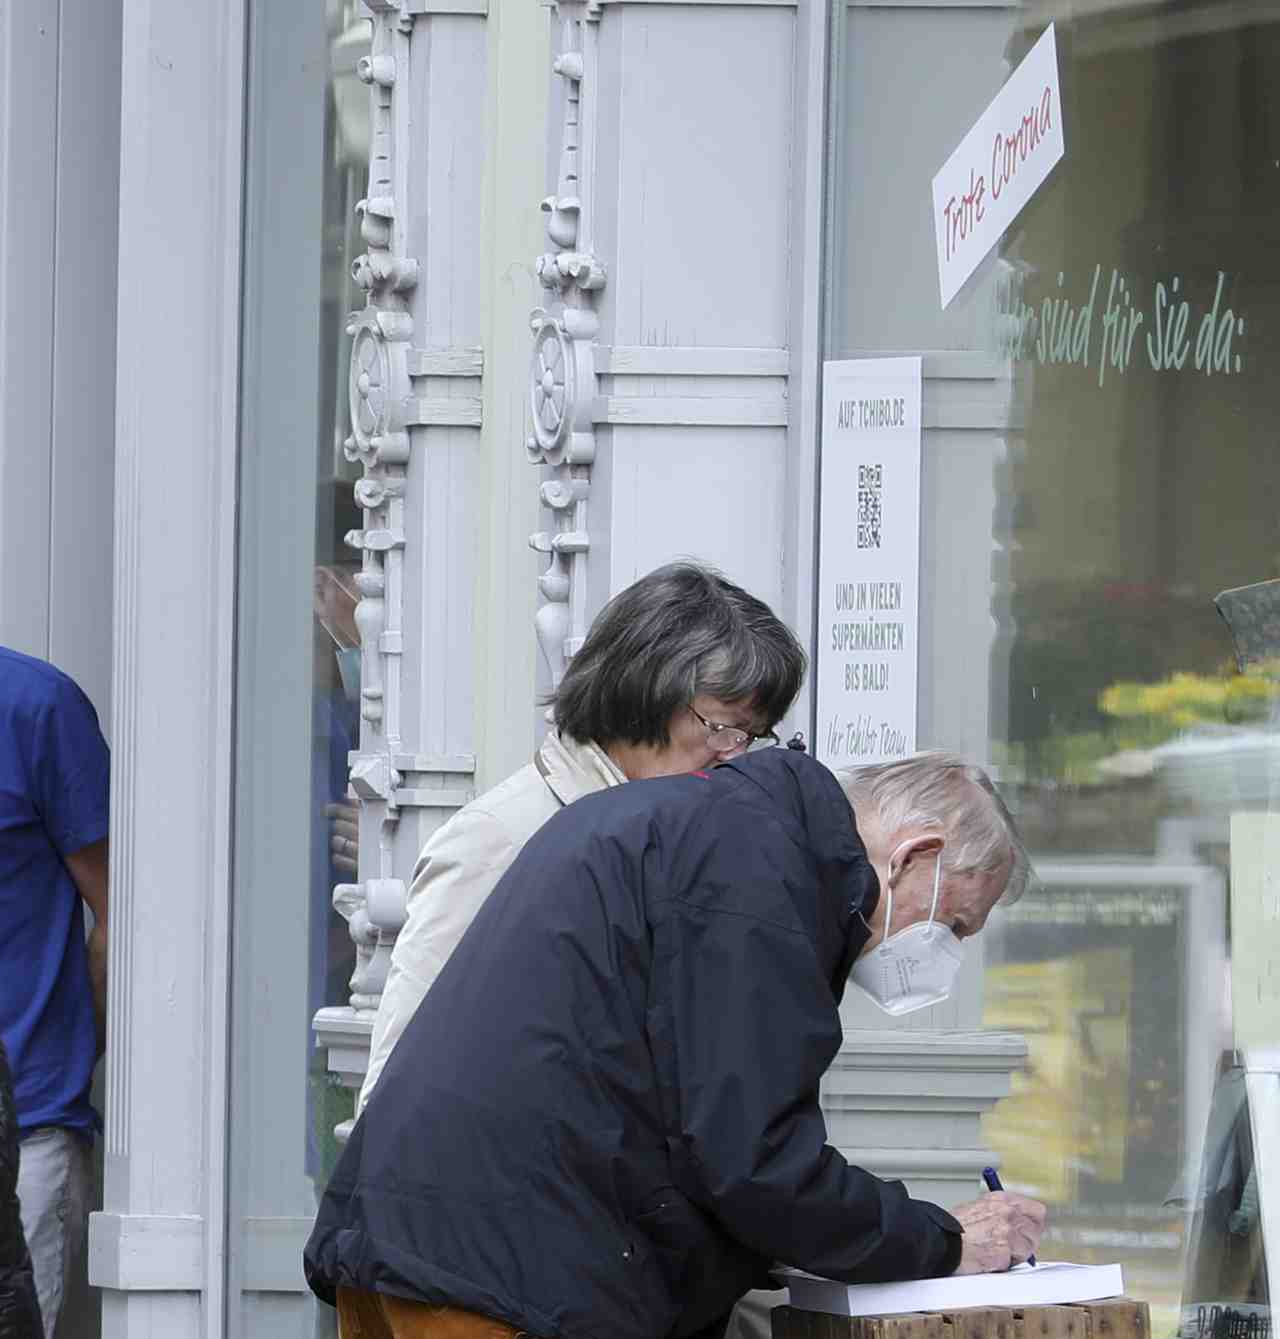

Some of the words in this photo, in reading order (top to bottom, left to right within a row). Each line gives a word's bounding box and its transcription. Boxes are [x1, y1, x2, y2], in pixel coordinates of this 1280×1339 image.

[991, 86, 1052, 200] Corona
[1037, 264, 1100, 368] sind
[1098, 269, 1144, 388] für
[1147, 276, 1191, 371] Sie
[838, 399, 856, 429] AUF
[858, 398, 905, 428] TCHIBO.DE
[835, 583, 854, 611] UND
[856, 583, 867, 610] IN
[869, 582, 902, 610] VIELEN
[831, 616, 904, 651] SUPERMÄRKTEN
[844, 663, 860, 692] BIS
[862, 663, 889, 691] BALD!
[826, 714, 844, 757] Ihr
[845, 714, 878, 756] Tchibo
